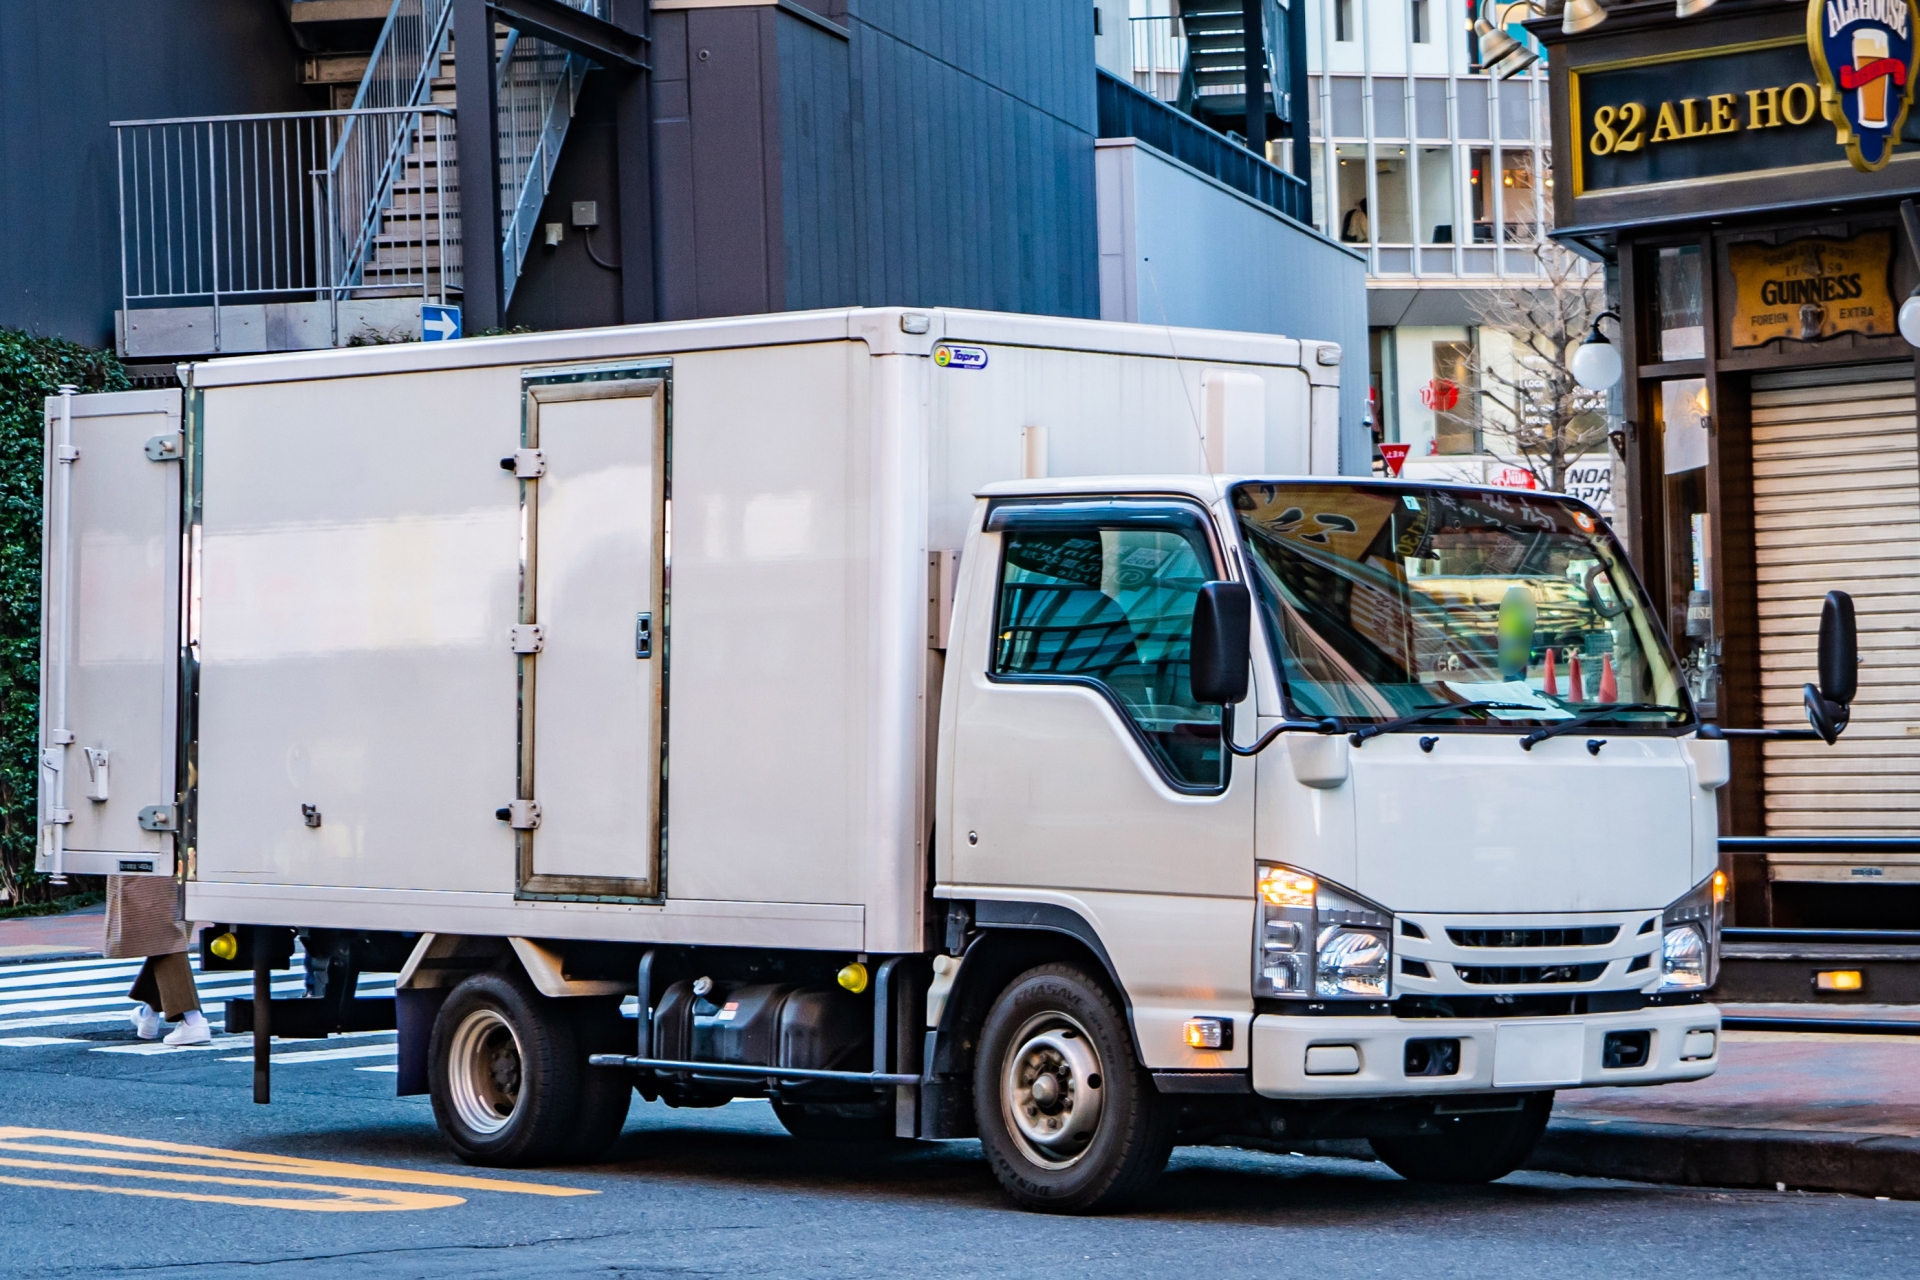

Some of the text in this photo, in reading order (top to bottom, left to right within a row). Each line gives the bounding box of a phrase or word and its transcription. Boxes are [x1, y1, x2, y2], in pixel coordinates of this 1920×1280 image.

[1590, 102, 1646, 156] 82
[1650, 93, 1739, 142] ALE
[1761, 273, 1862, 306] GUINNESS
[1751, 306, 1874, 327] FOREIGN EXTRA
[953, 349, 980, 361] Topre
[1569, 468, 1611, 484] NOA
